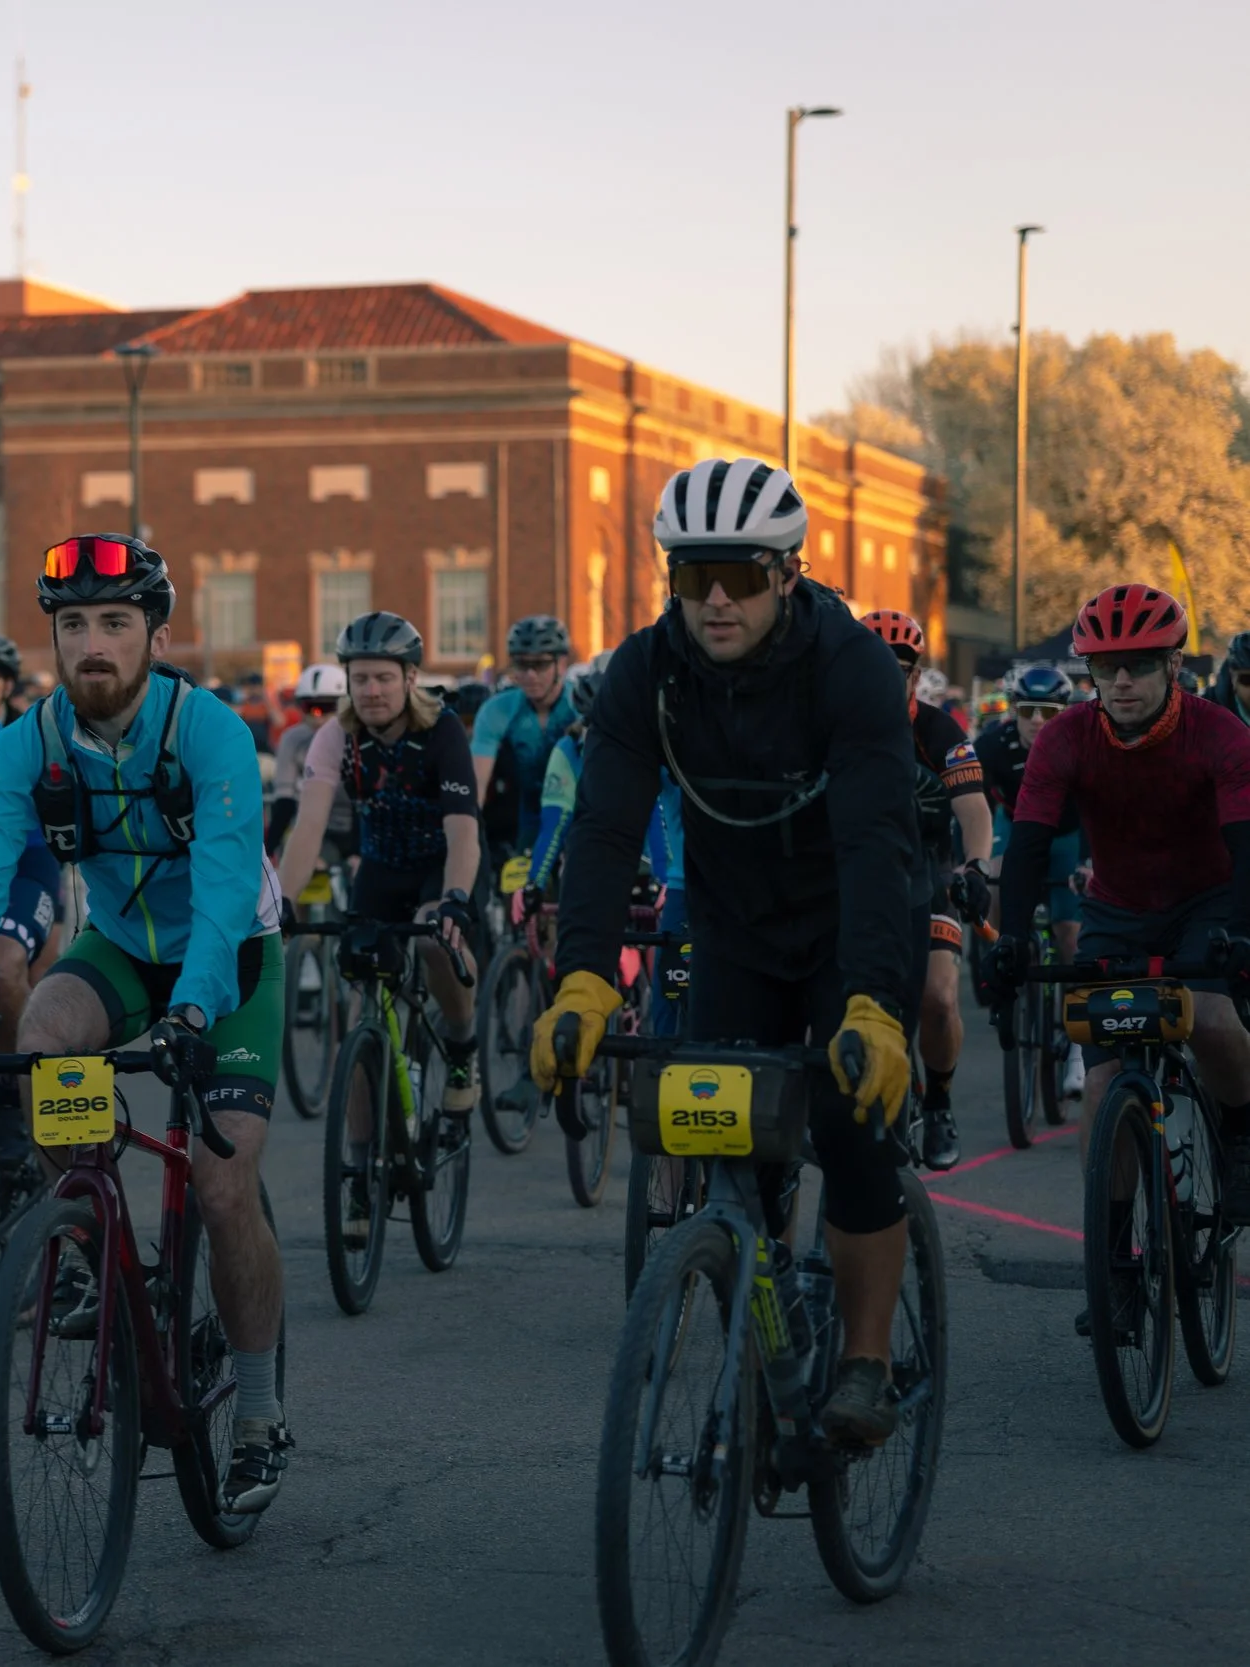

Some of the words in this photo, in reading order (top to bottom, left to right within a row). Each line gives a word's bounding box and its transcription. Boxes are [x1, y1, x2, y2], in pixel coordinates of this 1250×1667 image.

[666, 969, 690, 981] 10
[1101, 1016, 1148, 1031] 947
[39, 1096, 108, 1115] 2296
[672, 1110, 737, 1127] 2153
